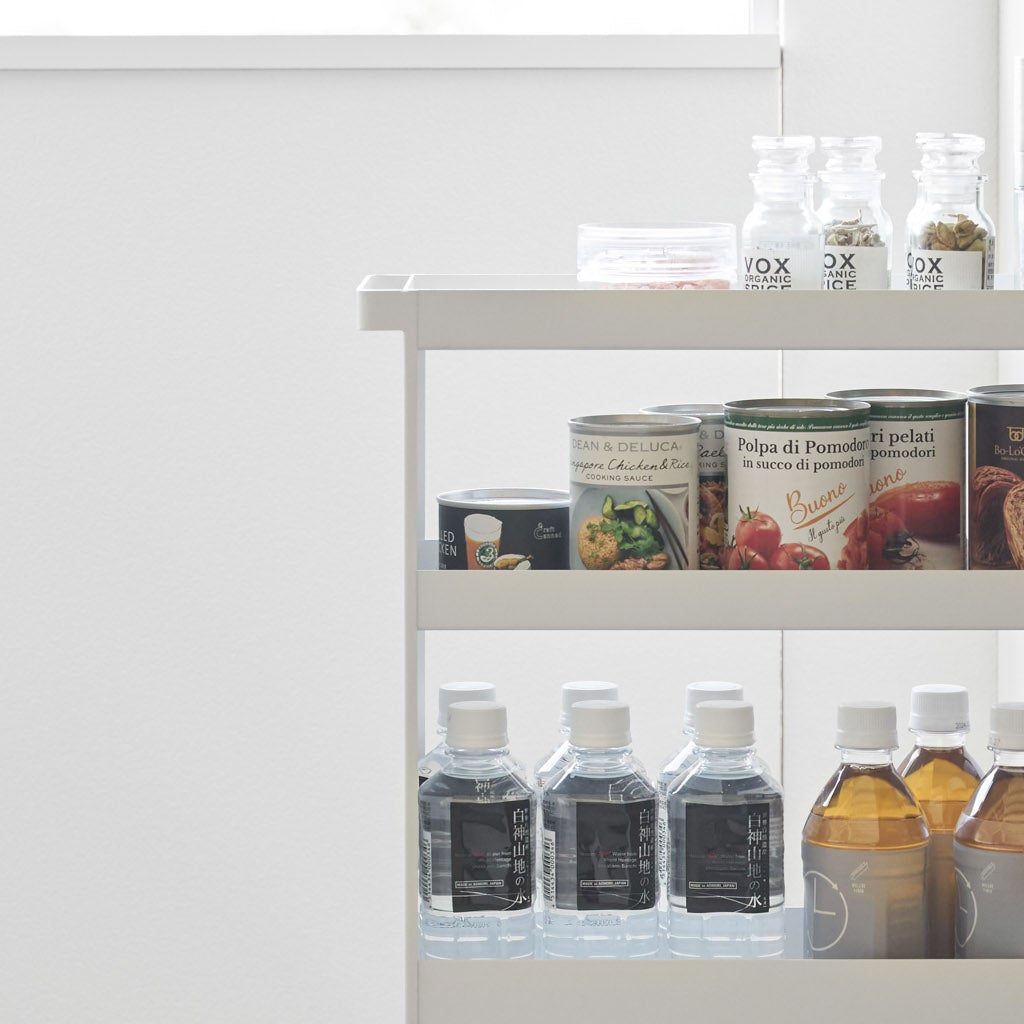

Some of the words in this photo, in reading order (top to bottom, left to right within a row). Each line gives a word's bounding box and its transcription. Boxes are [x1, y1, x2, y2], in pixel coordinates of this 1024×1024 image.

[744, 257, 791, 274] VOX
[745, 274, 792, 283] ORGANIC
[572, 439, 599, 450] DEAN
[603, 442, 613, 452] &
[618, 442, 679, 453] DELUCA
[889, 428, 935, 447] pelati
[738, 437, 778, 457] Polpa
[783, 439, 799, 454] di
[870, 446, 936, 460] pomodori
[743, 456, 753, 468] in
[756, 460, 793, 470] succo
[796, 458, 809, 470] di
[813, 455, 865, 473] pomodori
[585, 473, 621, 482] COOKING
[786, 481, 847, 524] Buono
[513, 808, 527, 904] 白神山地の水
[638, 808, 651, 904] 白神山地の水
[746, 812, 763, 908] 白神山地の水
